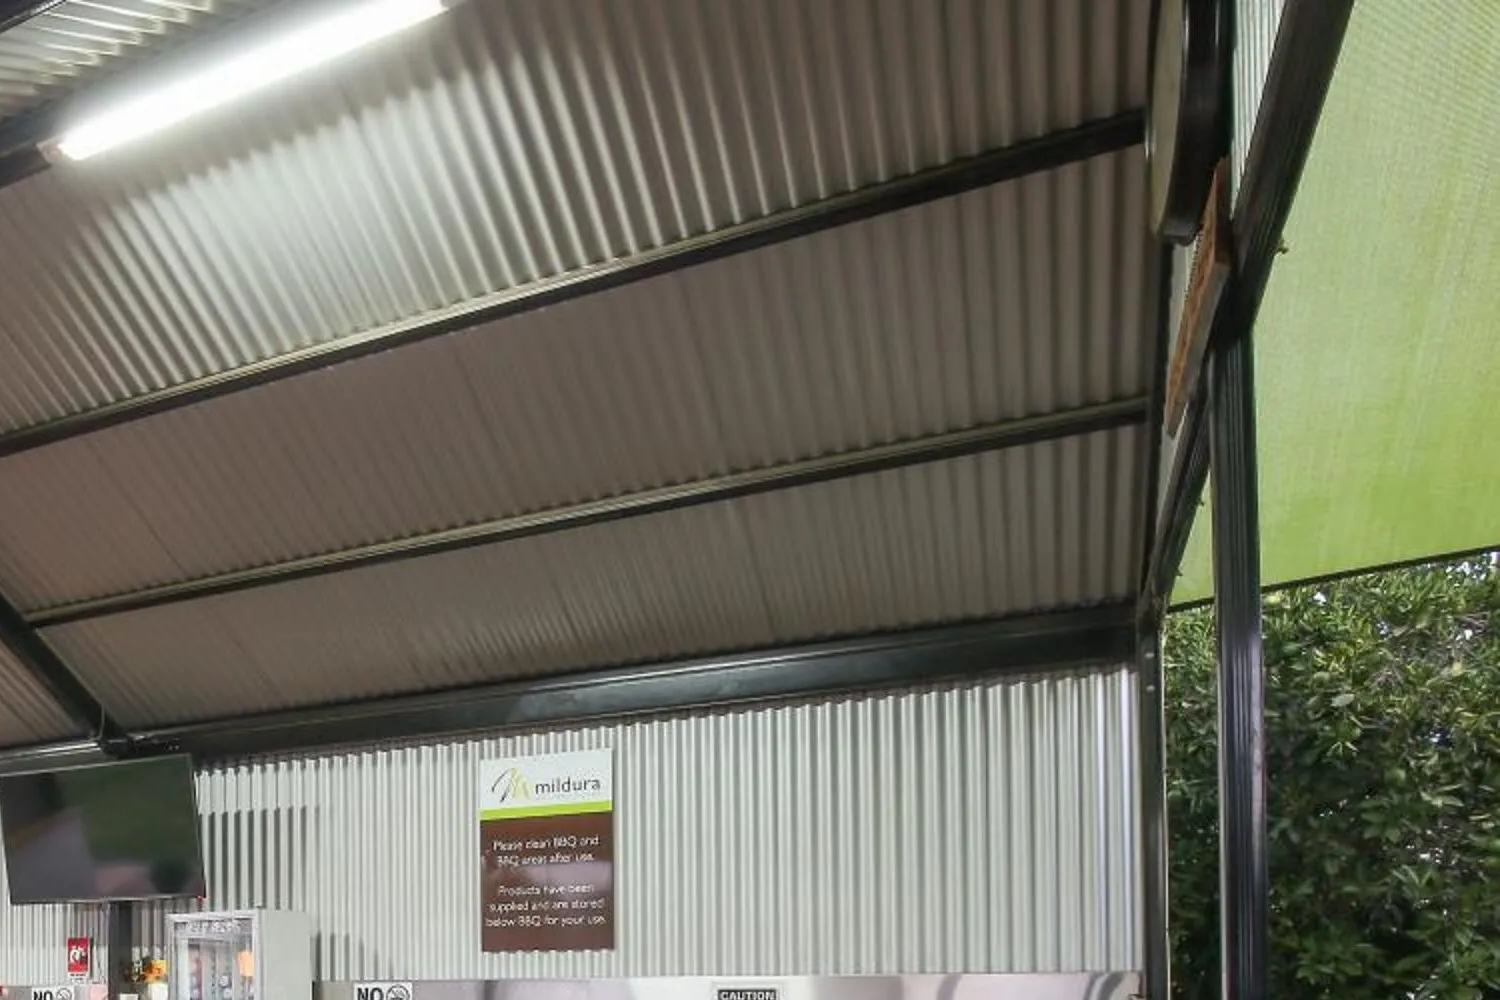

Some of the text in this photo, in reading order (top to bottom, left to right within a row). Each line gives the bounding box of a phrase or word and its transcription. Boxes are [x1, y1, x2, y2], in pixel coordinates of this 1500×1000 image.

[535, 777, 601, 795] mildura
[493, 834, 600, 852] Please clean BBQ and
[499, 885, 541, 897] Products
[485, 916, 515, 927] below
[720, 991, 775, 1000] CAUTION
